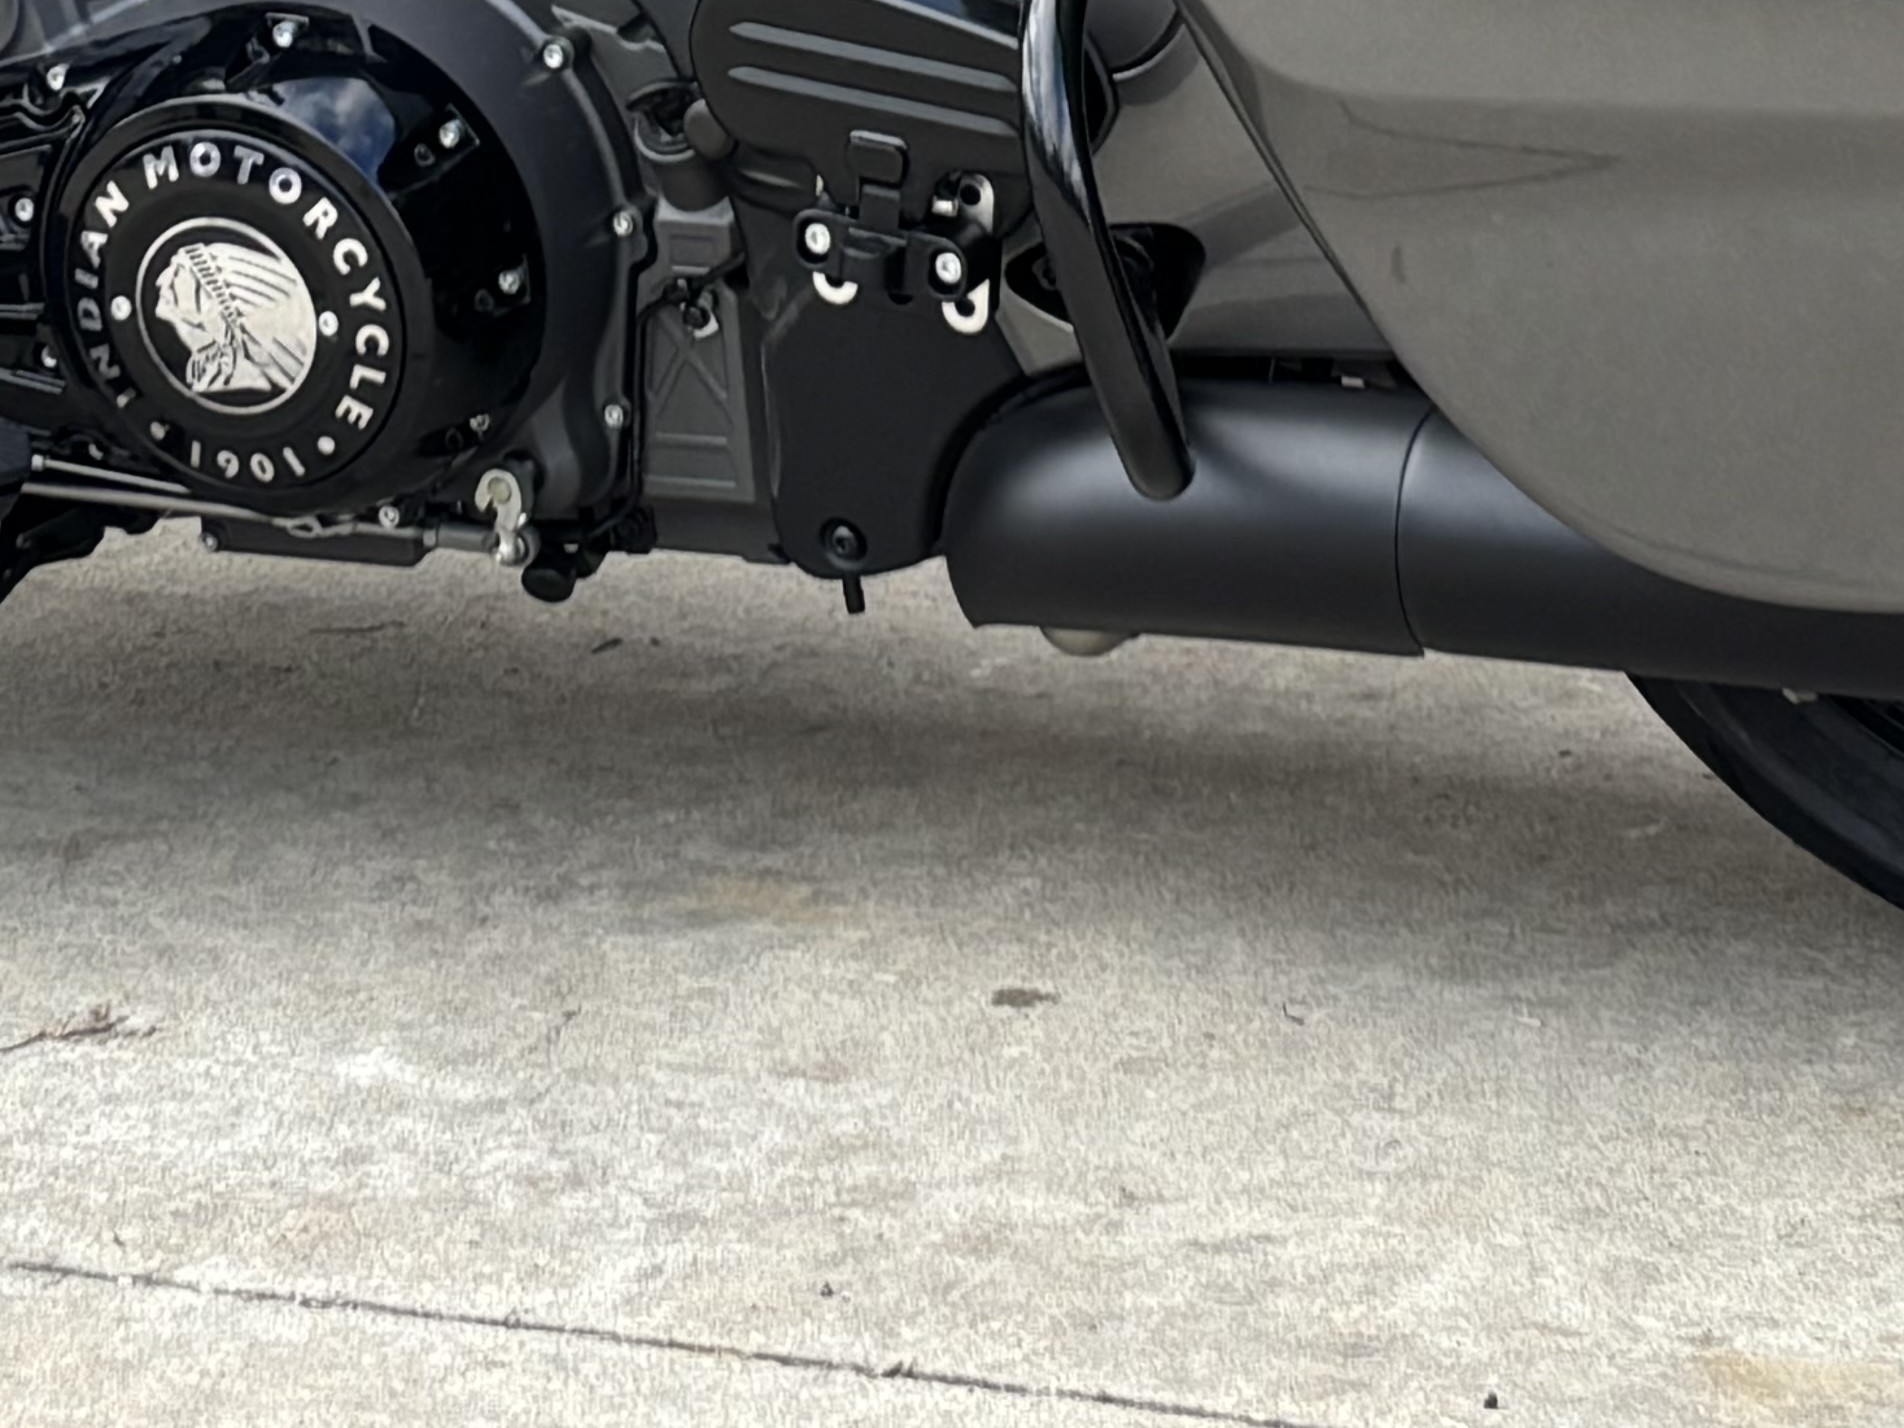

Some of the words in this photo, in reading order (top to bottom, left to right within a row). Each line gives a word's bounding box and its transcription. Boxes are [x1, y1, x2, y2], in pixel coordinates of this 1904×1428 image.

[74, 180, 137, 410] INDIAN
[143, 141, 390, 431] MOTORCYCLE
[190, 439, 306, 485] 1901
